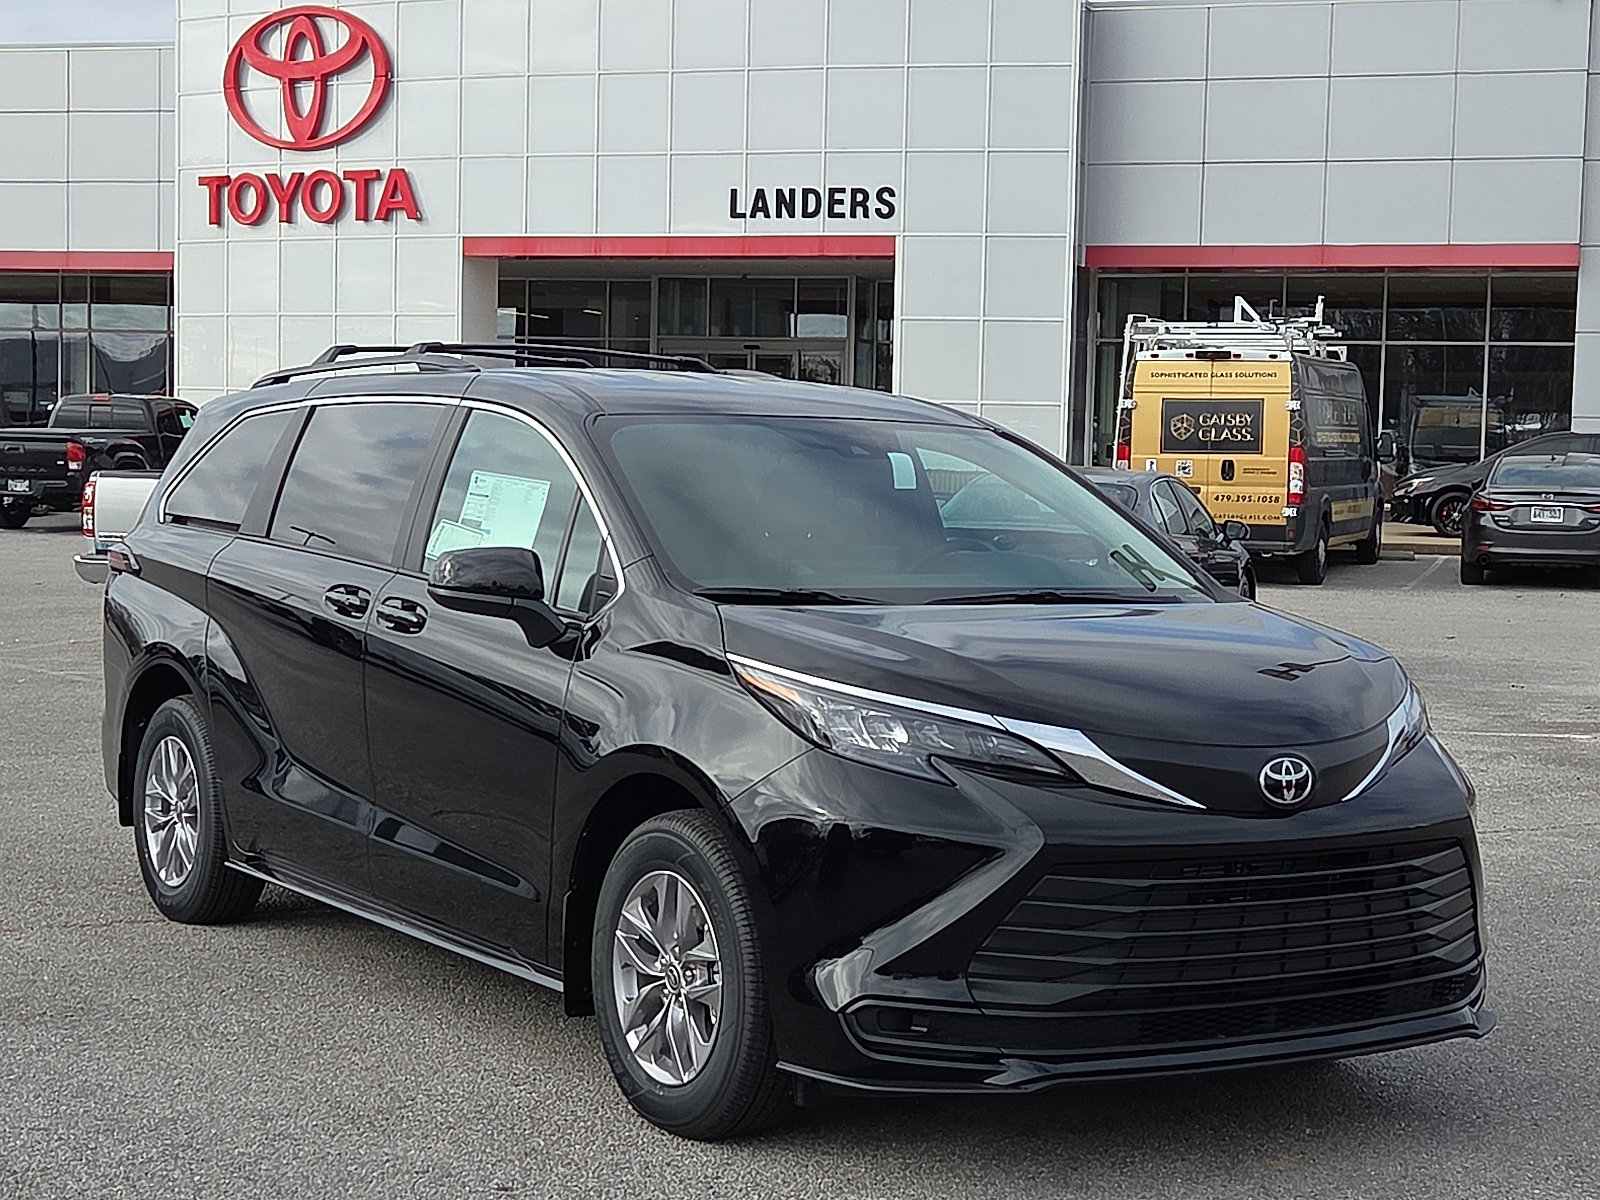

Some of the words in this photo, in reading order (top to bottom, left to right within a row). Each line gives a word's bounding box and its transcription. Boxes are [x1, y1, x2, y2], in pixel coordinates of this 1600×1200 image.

[198, 168, 421, 226] TOYOTA
[730, 186, 897, 219] LANDERS
[1150, 371, 1209, 379] SOPHISTICATED
[1210, 371, 1233, 379] GLASS
[1234, 371, 1278, 379] SOLUTIONS
[1198, 412, 1255, 426] GATSBY
[1213, 494, 1281, 504] 479.395.1058
